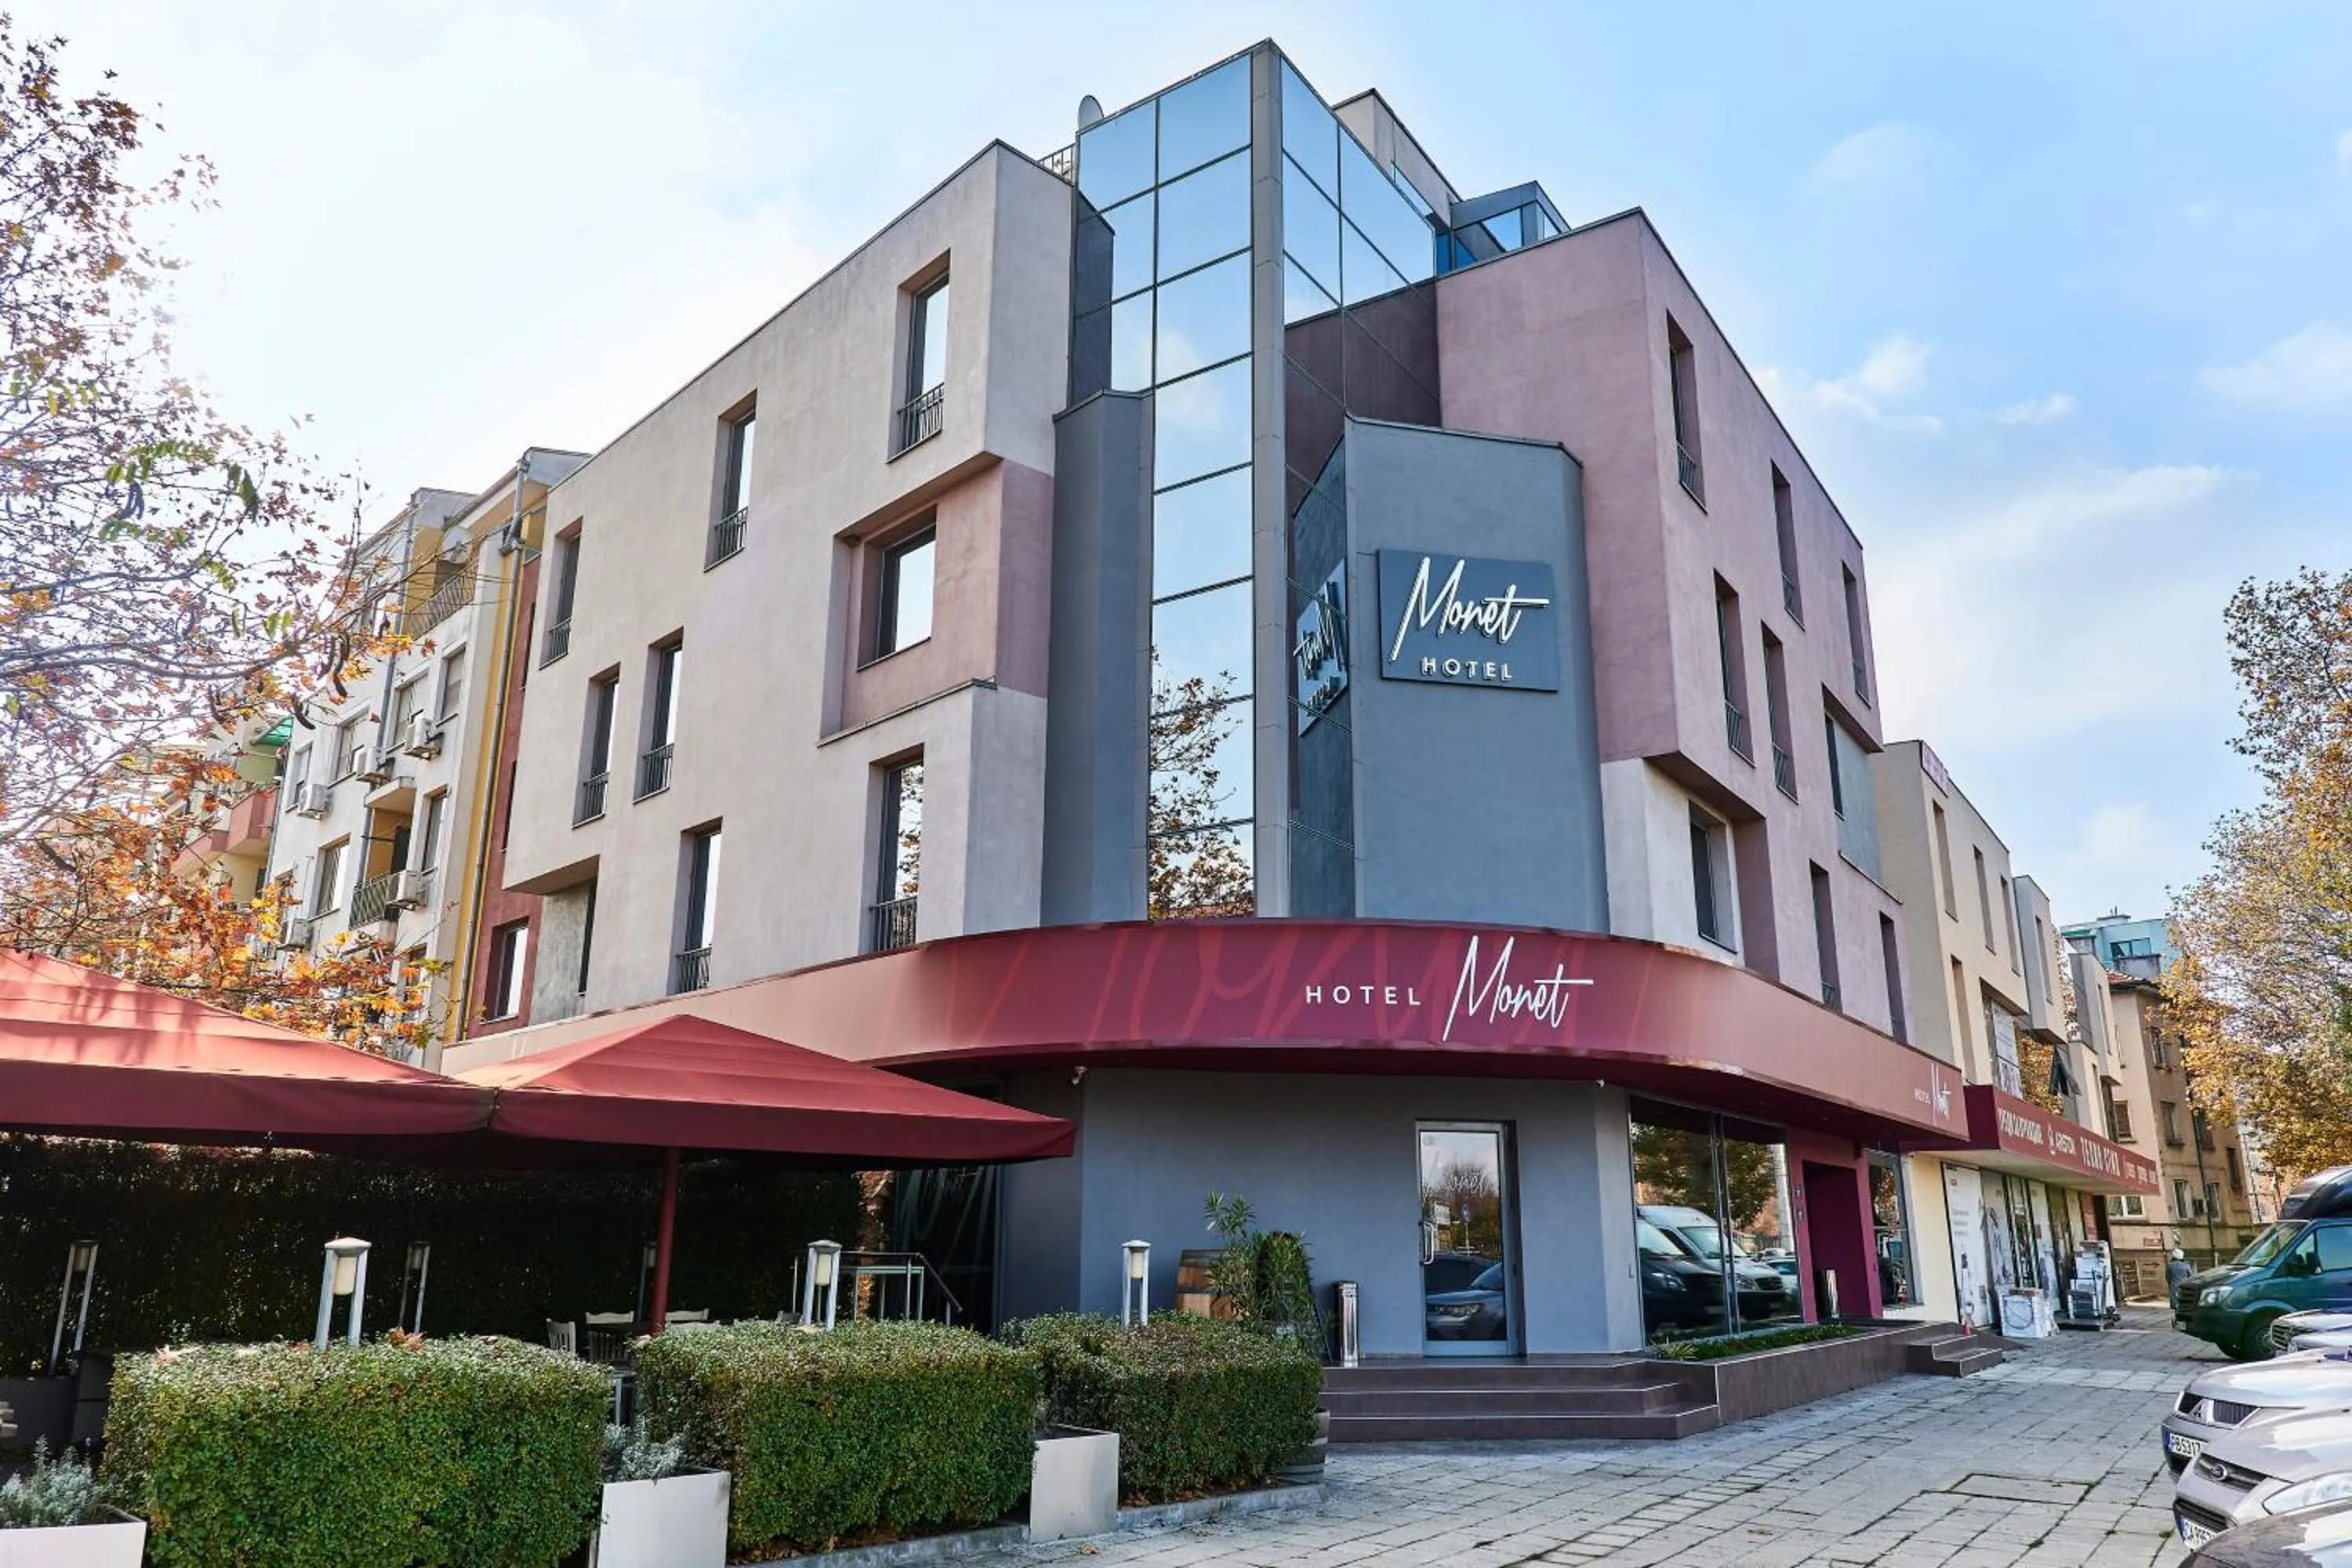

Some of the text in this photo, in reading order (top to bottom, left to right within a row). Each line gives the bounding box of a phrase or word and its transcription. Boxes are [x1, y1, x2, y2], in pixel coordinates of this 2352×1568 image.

[1390, 556, 1550, 662] Monet
[1421, 657, 1512, 681] HOTEL
[1305, 935, 1595, 1043] HOTEL Monet
